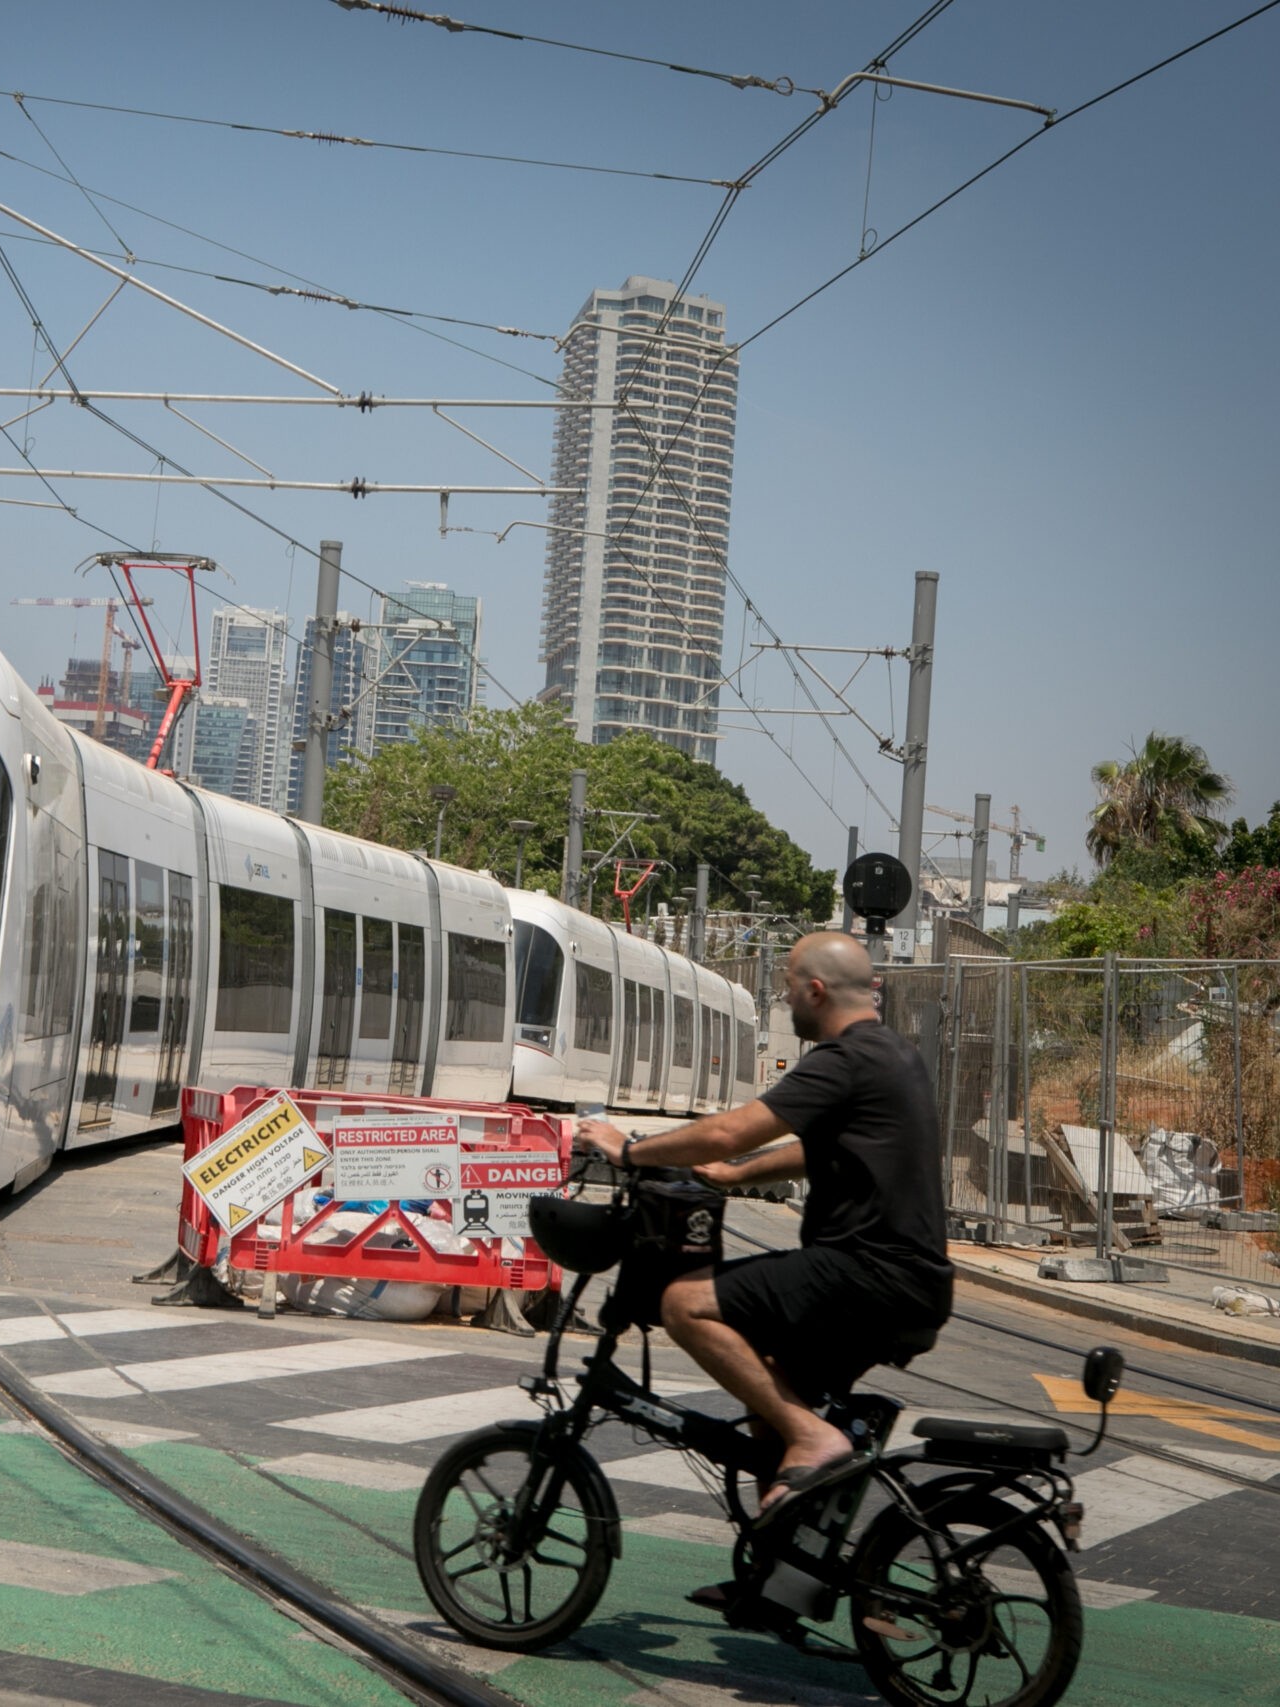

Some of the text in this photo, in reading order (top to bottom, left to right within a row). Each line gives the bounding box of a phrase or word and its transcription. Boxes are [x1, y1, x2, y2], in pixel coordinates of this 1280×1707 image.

[900, 930, 909, 941] 12
[900, 942, 906, 951] 8
[338, 1128, 456, 1143] RESTRICTED AREA
[199, 1108, 292, 1184] ELECTRICITY
[211, 1171, 245, 1199] DANGER
[246, 1154, 267, 1173] HIGH
[268, 1127, 304, 1156] VOLTAGE
[256, 1166, 273, 1181] מתח
